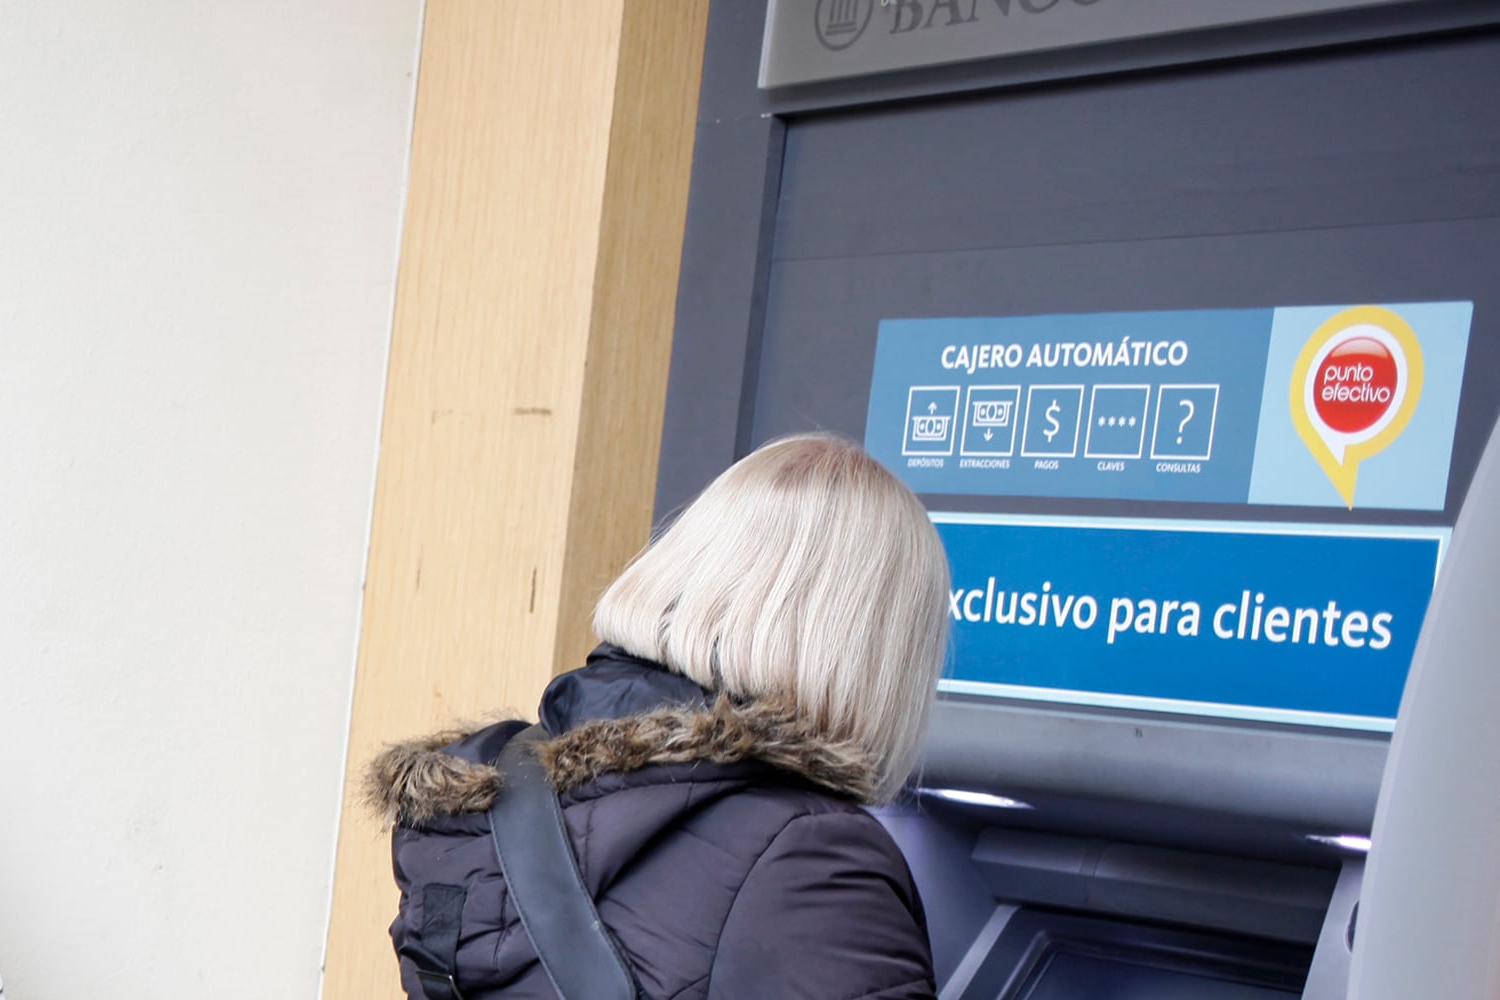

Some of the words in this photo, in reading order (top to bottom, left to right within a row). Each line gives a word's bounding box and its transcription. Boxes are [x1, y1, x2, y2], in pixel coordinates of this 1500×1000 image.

[940, 343, 1023, 375] CAJERO
[1025, 336, 1189, 369] AUTOMÁTICO
[1323, 362, 1374, 385] punto
[1321, 382, 1391, 403] efectivo
[959, 459, 1011, 470] EXTRACCIONES
[1034, 459, 1060, 471] PAGOS
[1097, 460, 1125, 472] CLAVES
[1156, 462, 1202, 474] CONSULTAS
[947, 576, 1098, 630] xclusivo
[1106, 592, 1201, 645] para
[1212, 590, 1394, 650] clientes
